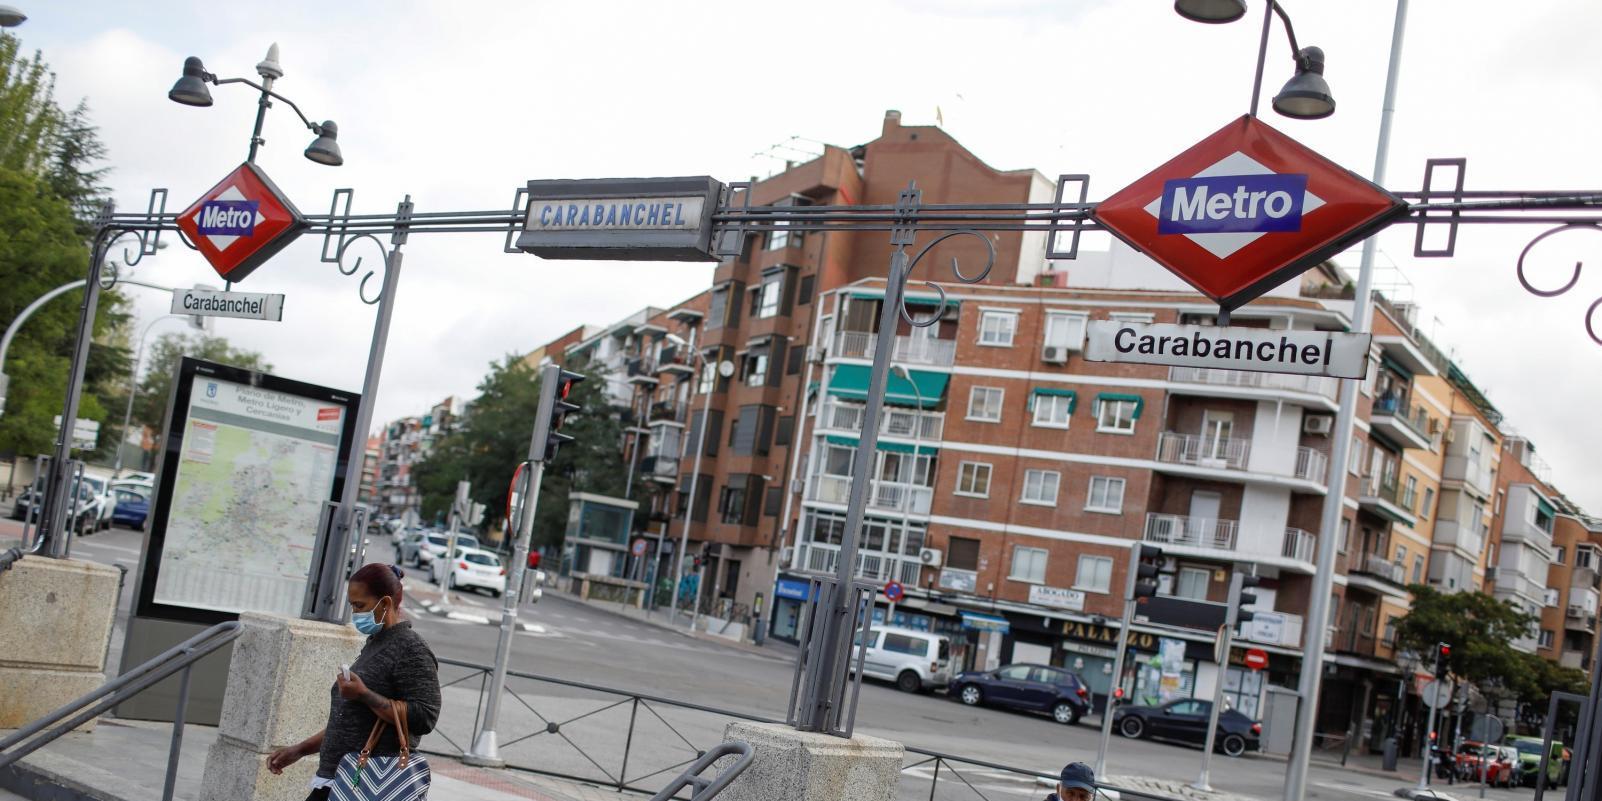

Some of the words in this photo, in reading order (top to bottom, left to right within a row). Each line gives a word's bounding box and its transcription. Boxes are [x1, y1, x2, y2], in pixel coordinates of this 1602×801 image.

[540, 202, 686, 227] CARABANCHEL
[1170, 185, 1293, 222] Metro
[202, 205, 252, 229] Metro
[183, 293, 264, 314] Carabanchel
[1114, 327, 1333, 366] Carabanchel
[235, 385, 262, 398] Plano
[263, 391, 276, 400] de
[237, 395, 264, 407] Metro
[266, 401, 295, 413] Ligero
